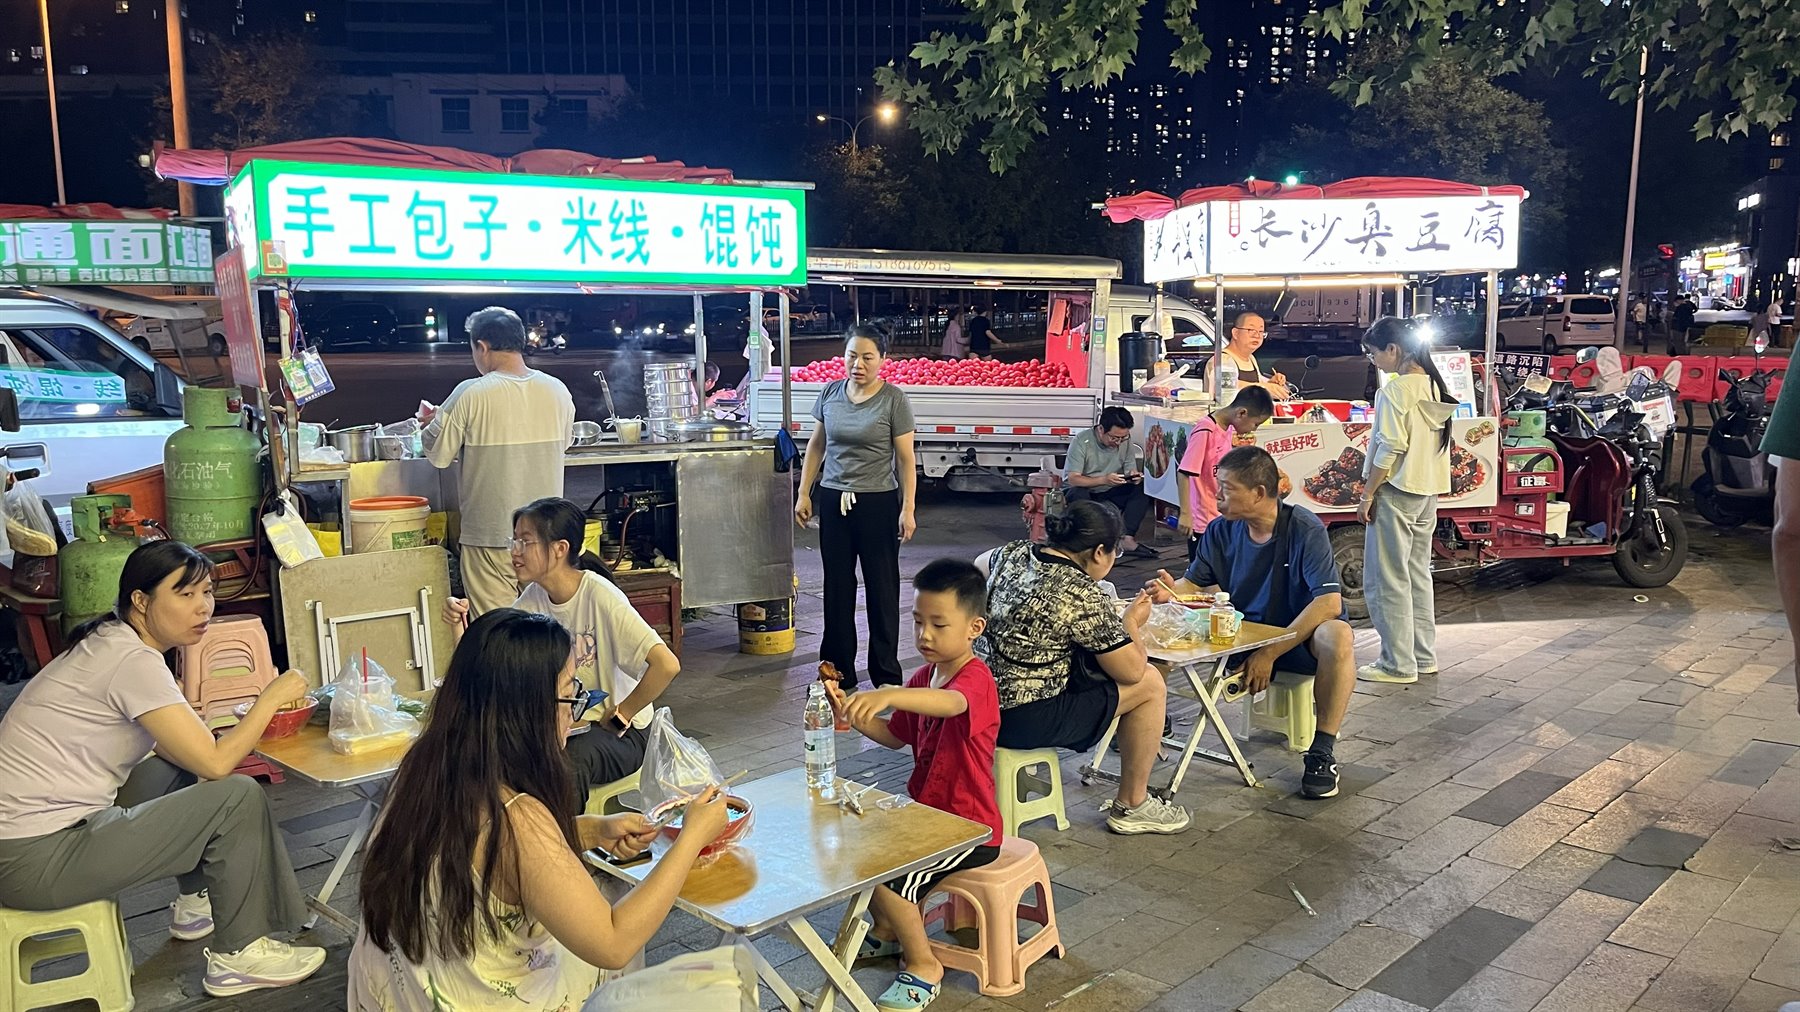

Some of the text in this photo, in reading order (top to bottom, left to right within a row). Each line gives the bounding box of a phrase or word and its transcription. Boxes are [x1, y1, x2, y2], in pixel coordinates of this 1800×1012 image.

[284, 186, 783, 268] 手工包子·米线·馄饨
[1251, 200, 1505, 261] 长沙臭豆腐
[1494, 354, 1544, 367] 道路沉陷
[1266, 433, 1319, 454] 就是好吃
